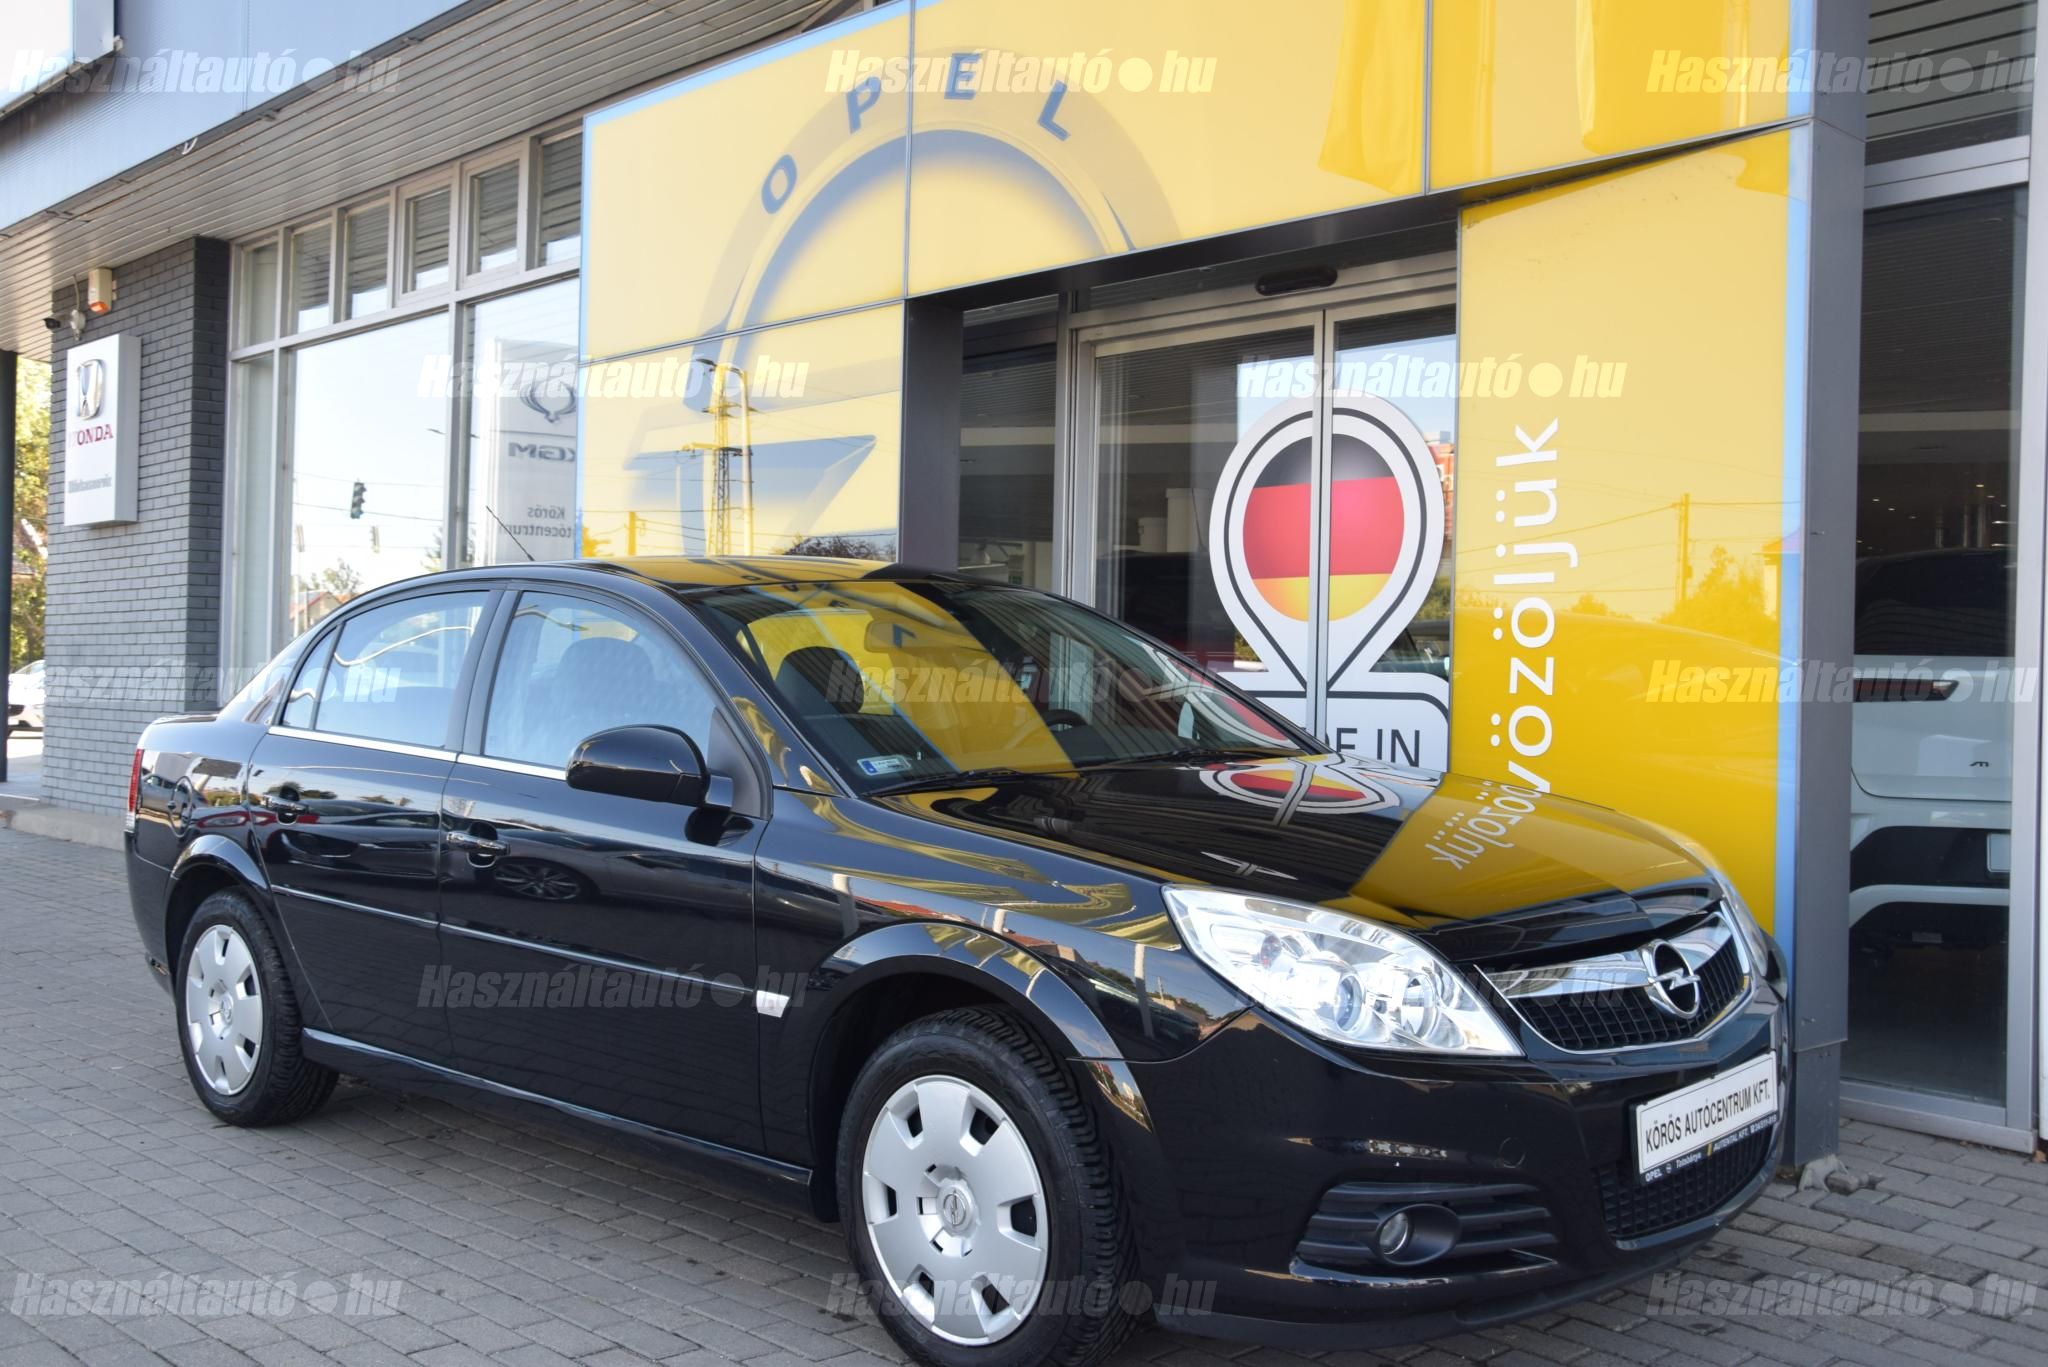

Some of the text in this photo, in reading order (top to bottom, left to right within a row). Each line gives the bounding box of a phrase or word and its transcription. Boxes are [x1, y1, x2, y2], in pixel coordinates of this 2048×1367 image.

[761, 52, 1071, 215] OPEL
[1376, 727, 1421, 768] IN
[1684, 1086, 1752, 1137] AUTÓCENTRUM
[1752, 1078, 1770, 1104] KFT.
